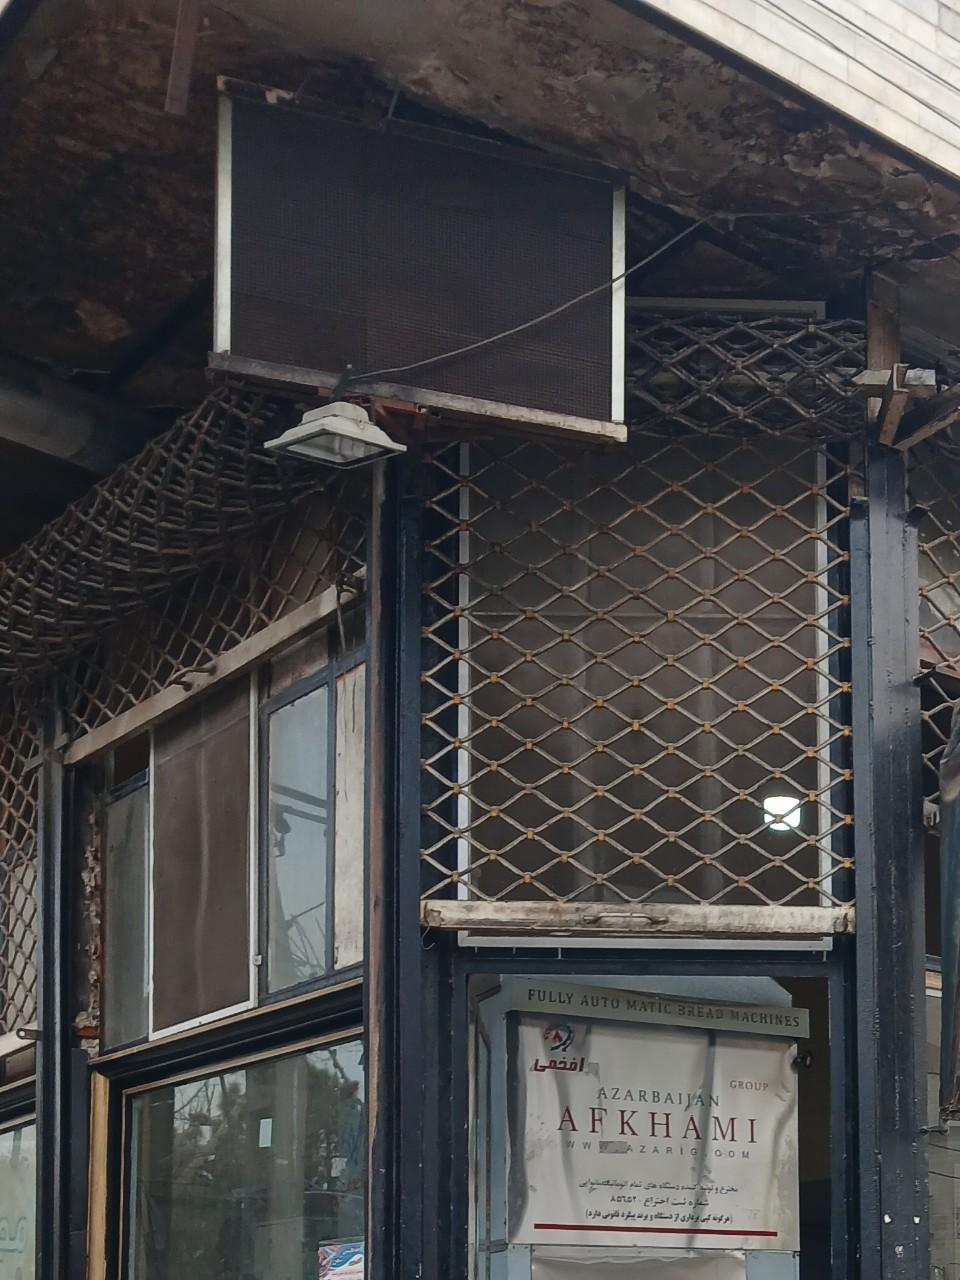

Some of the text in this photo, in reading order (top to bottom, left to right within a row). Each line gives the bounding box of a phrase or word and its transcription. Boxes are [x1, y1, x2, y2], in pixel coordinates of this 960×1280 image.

[528, 988, 800, 1028] FULLY AUTO MATIC BREAD MACHINES
[533, 1057, 585, 1073] افخمی
[729, 1080, 769, 1092] GROUP
[597, 1087, 719, 1111] AZARBAIJAN
[557, 1105, 758, 1143] AFKHAMI
